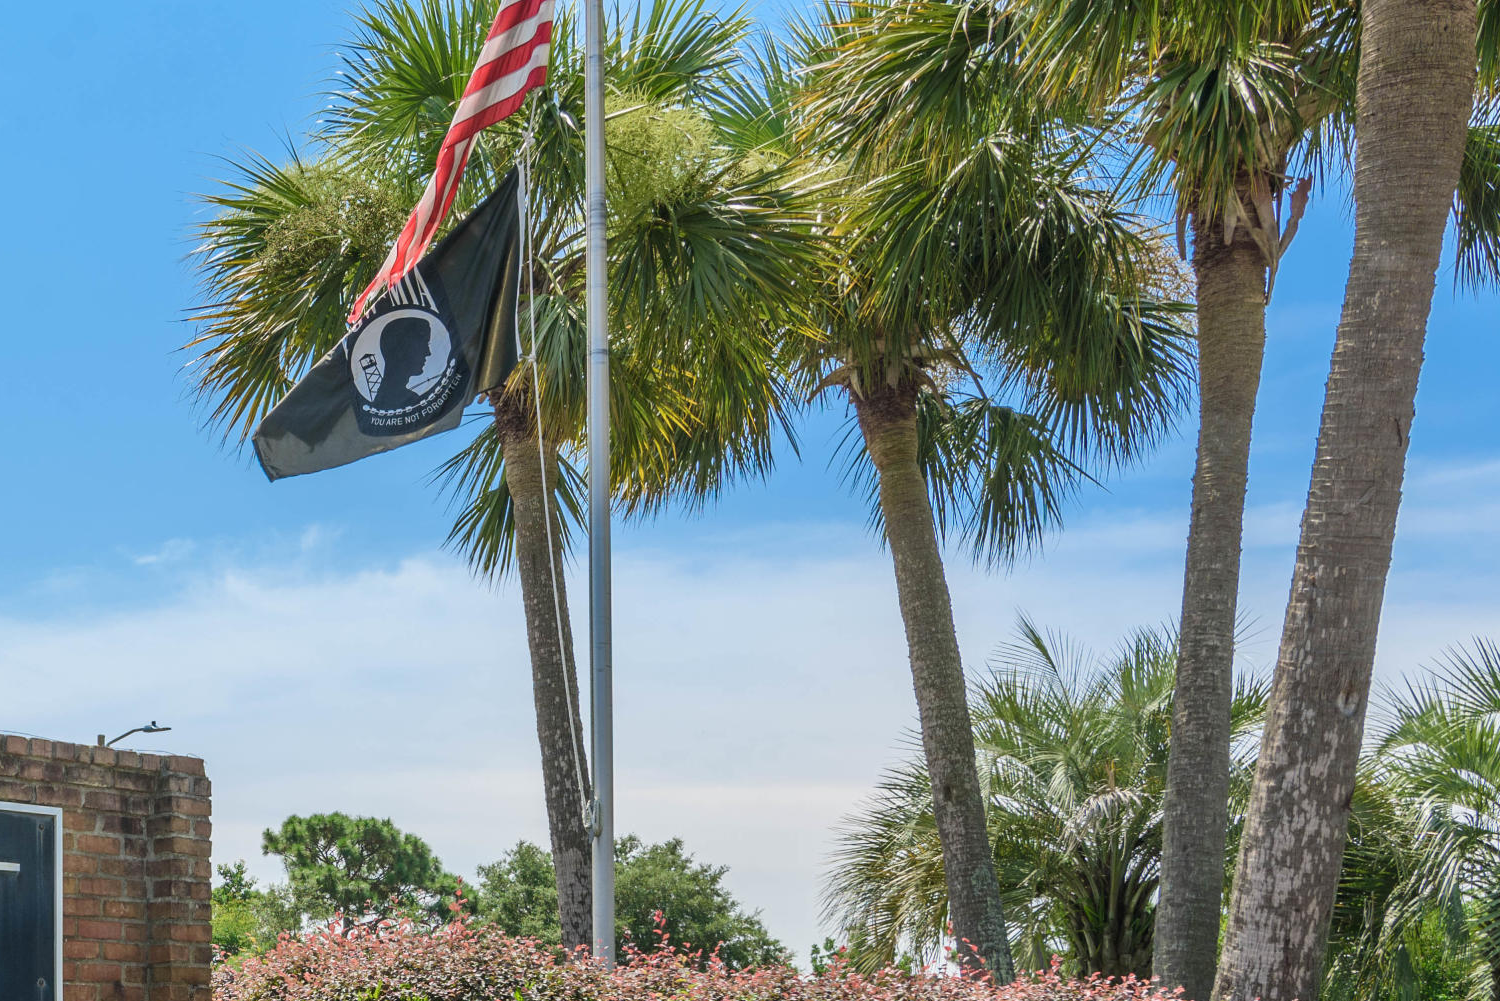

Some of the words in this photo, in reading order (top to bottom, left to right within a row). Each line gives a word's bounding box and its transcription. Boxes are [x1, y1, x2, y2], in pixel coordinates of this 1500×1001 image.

[370, 416, 385, 426] YOU
[385, 417, 404, 427] ARE
[404, 412, 420, 425] NOT
[421, 373, 463, 417] FORGOTTEN
